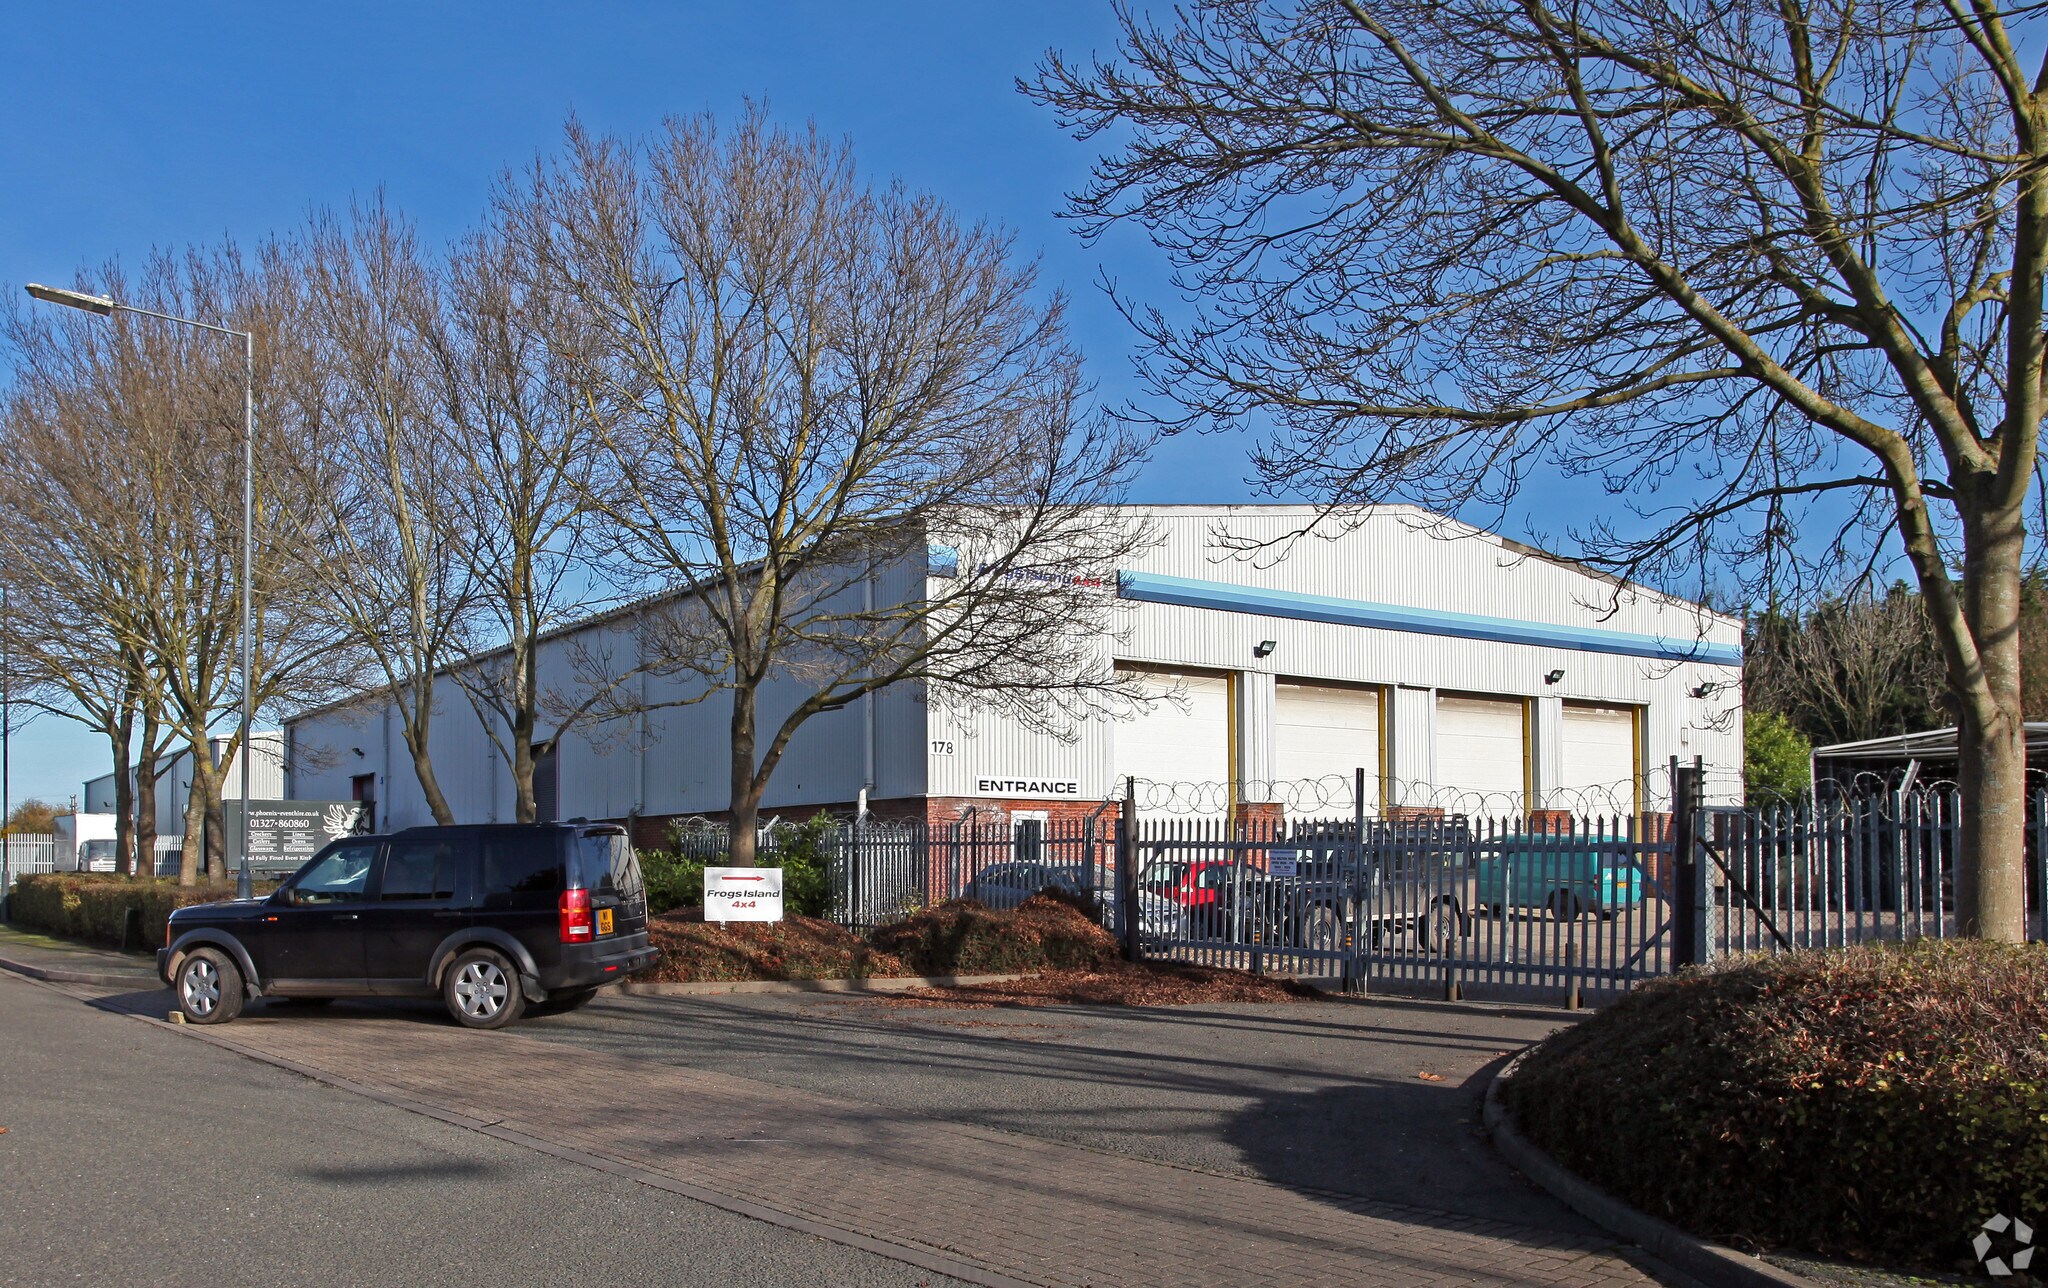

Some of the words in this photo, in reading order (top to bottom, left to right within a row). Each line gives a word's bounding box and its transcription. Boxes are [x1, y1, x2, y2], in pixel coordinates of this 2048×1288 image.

[931, 741, 953, 754] 178
[978, 780, 1077, 793] ENTRANCE
[706, 889, 742, 899] Frogs
[743, 889, 781, 898] Island
[731, 900, 756, 908] 4x4
